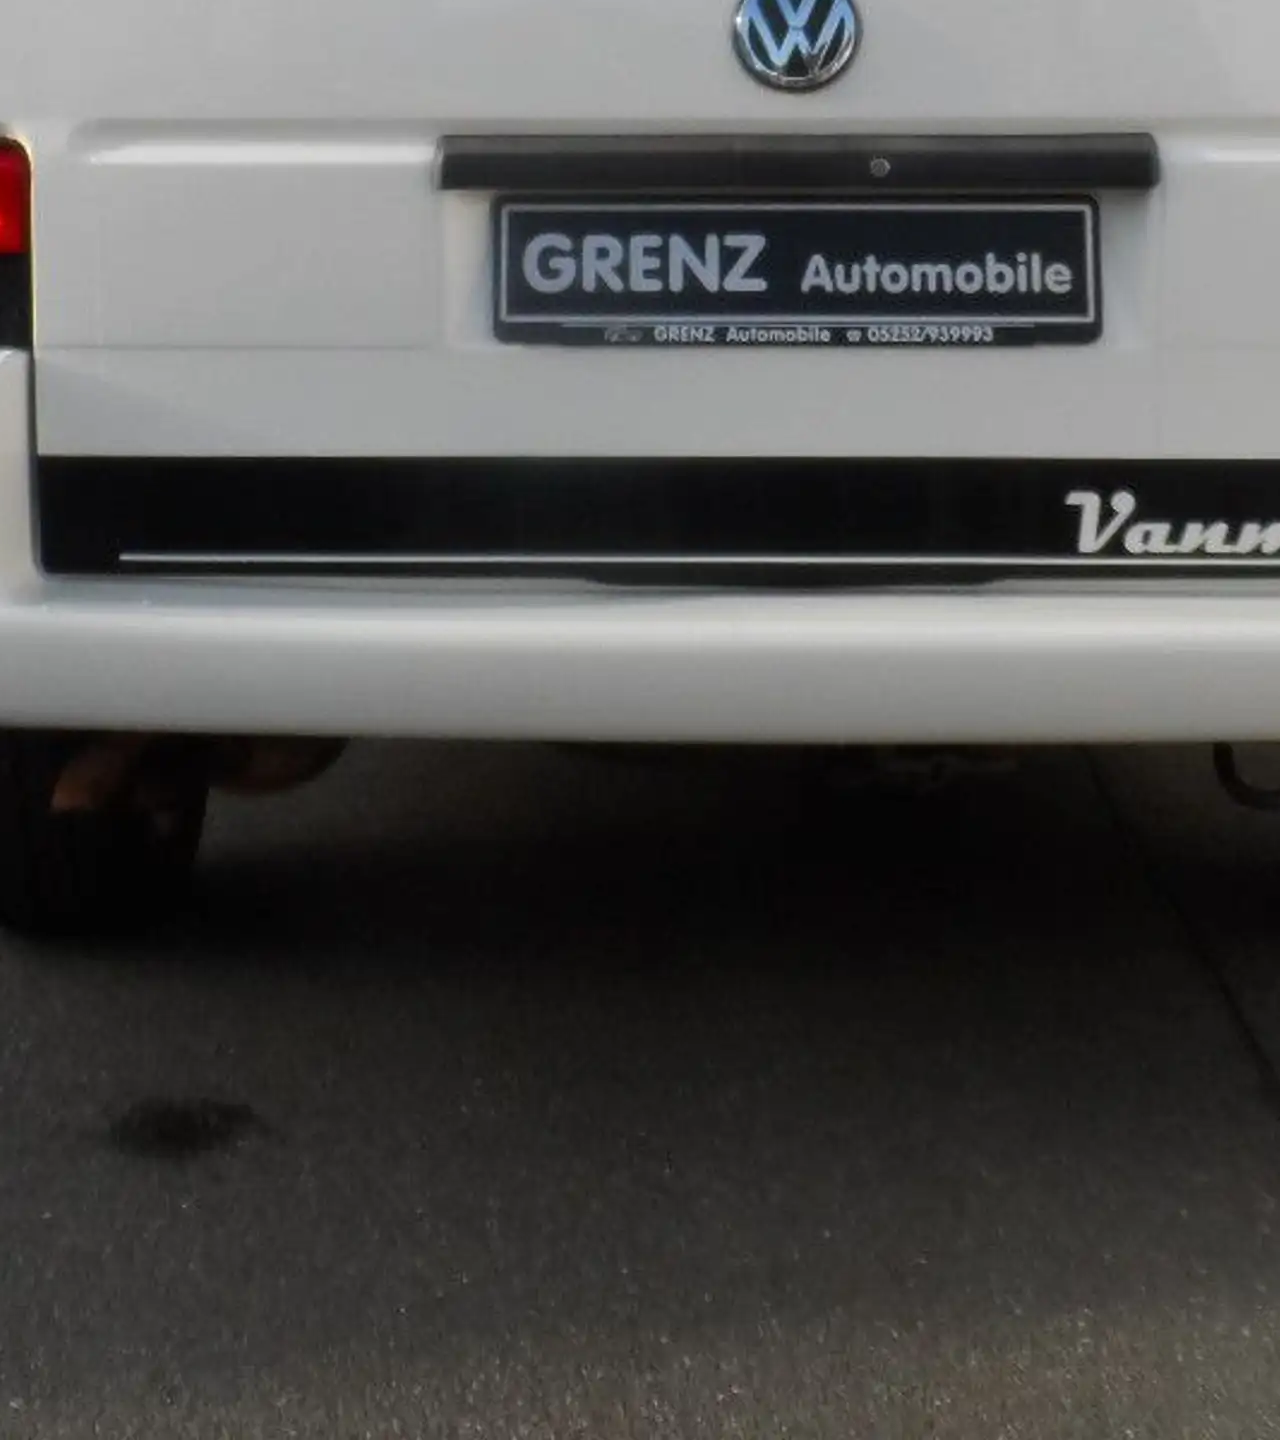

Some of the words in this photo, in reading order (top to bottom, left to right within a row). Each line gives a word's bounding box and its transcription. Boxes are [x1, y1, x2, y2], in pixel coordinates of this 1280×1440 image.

[521, 232, 768, 294] GRENZ
[800, 252, 1074, 295] Automobile
[653, 325, 715, 343] GRENZ
[725, 324, 831, 343] Automobile
